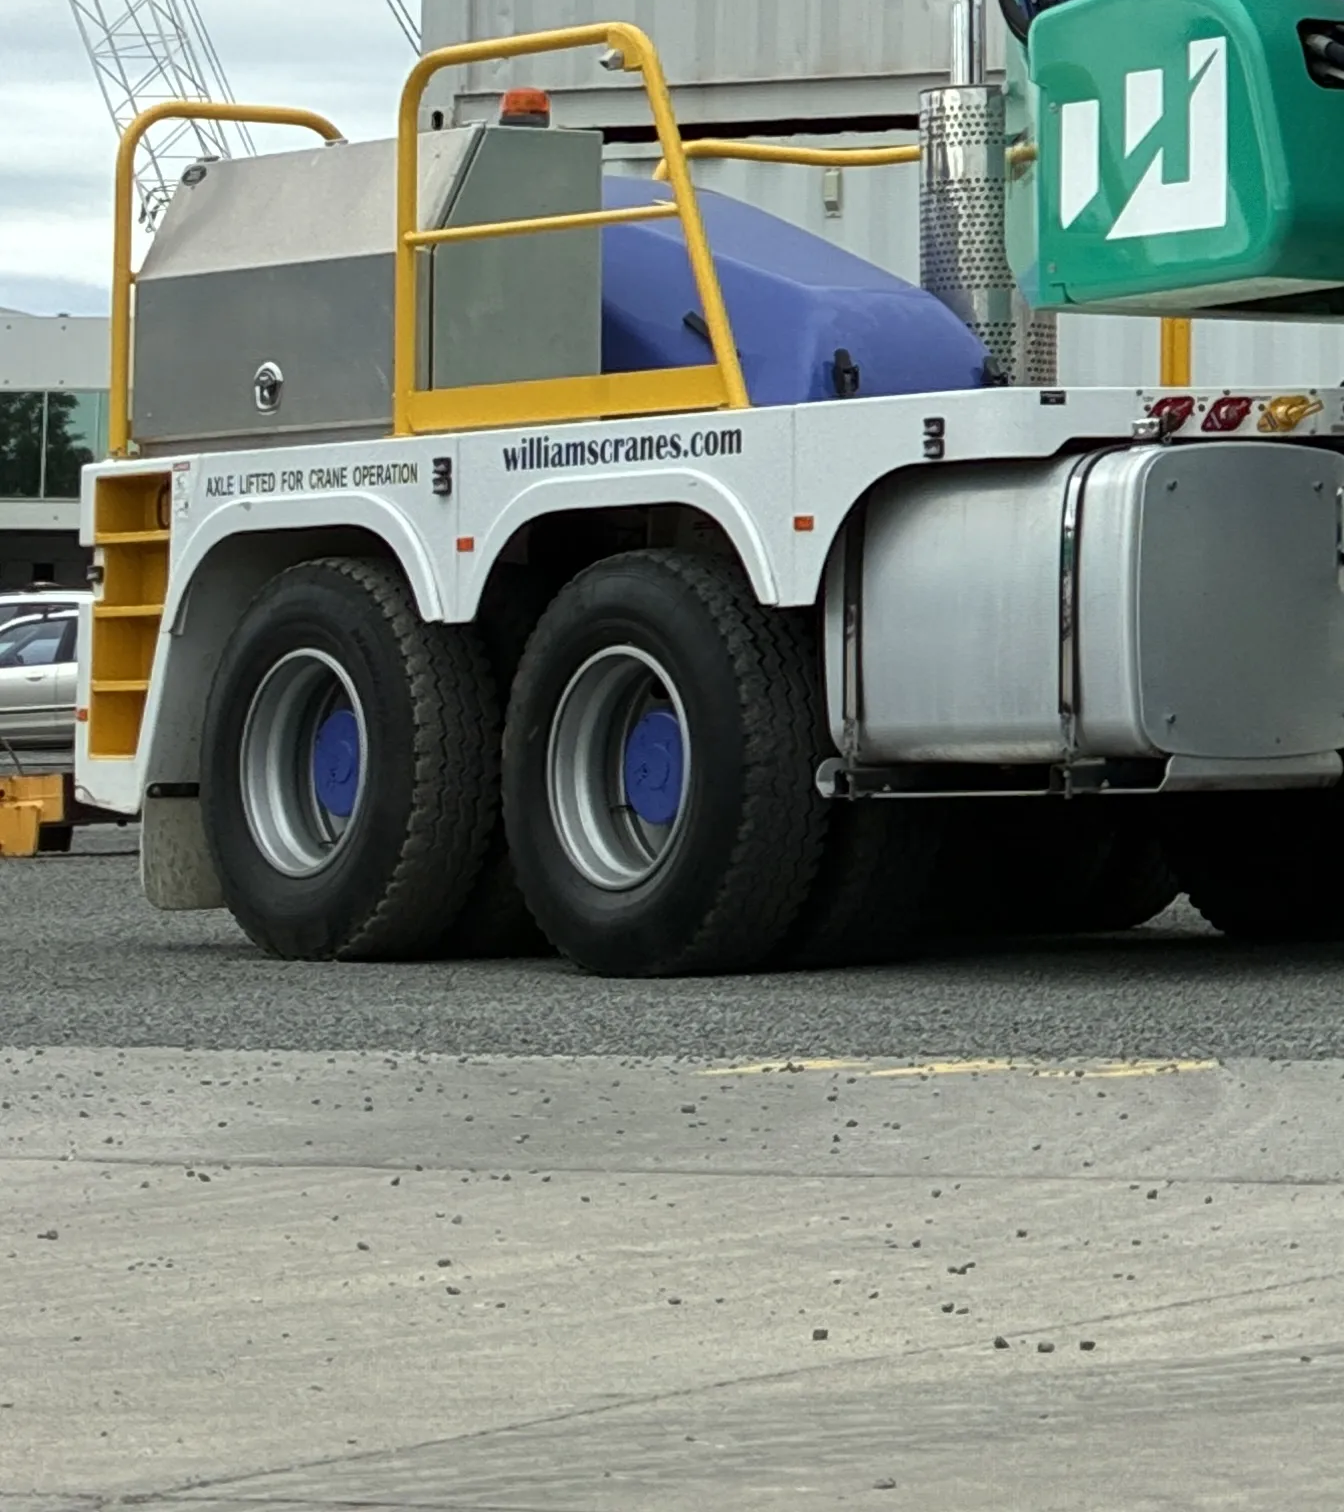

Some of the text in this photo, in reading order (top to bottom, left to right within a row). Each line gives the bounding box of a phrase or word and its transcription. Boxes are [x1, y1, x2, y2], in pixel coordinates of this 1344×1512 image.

[503, 427, 743, 472] williamscranes.com
[206, 475, 235, 498] AXLE
[238, 471, 276, 494] LIFTED
[281, 470, 304, 492] FOR
[308, 466, 348, 489] CRANE
[352, 462, 419, 487] OPERATION
